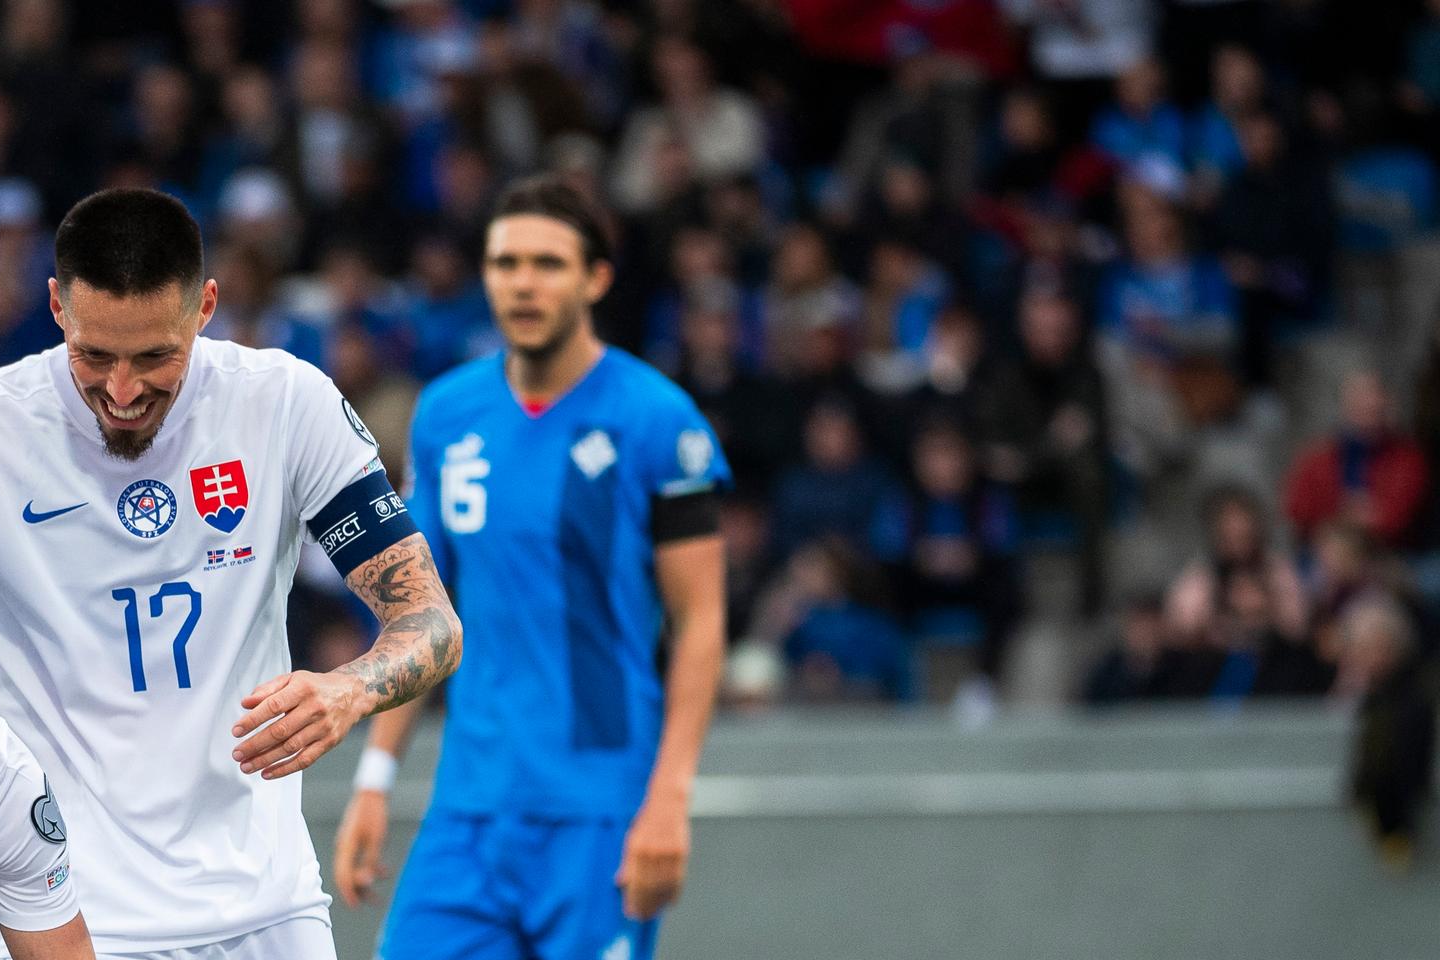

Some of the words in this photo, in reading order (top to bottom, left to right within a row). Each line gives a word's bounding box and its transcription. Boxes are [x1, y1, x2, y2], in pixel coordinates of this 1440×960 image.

[440, 458, 491, 534] 6
[322, 517, 361, 553] ESPECT
[111, 581, 202, 693] 17
